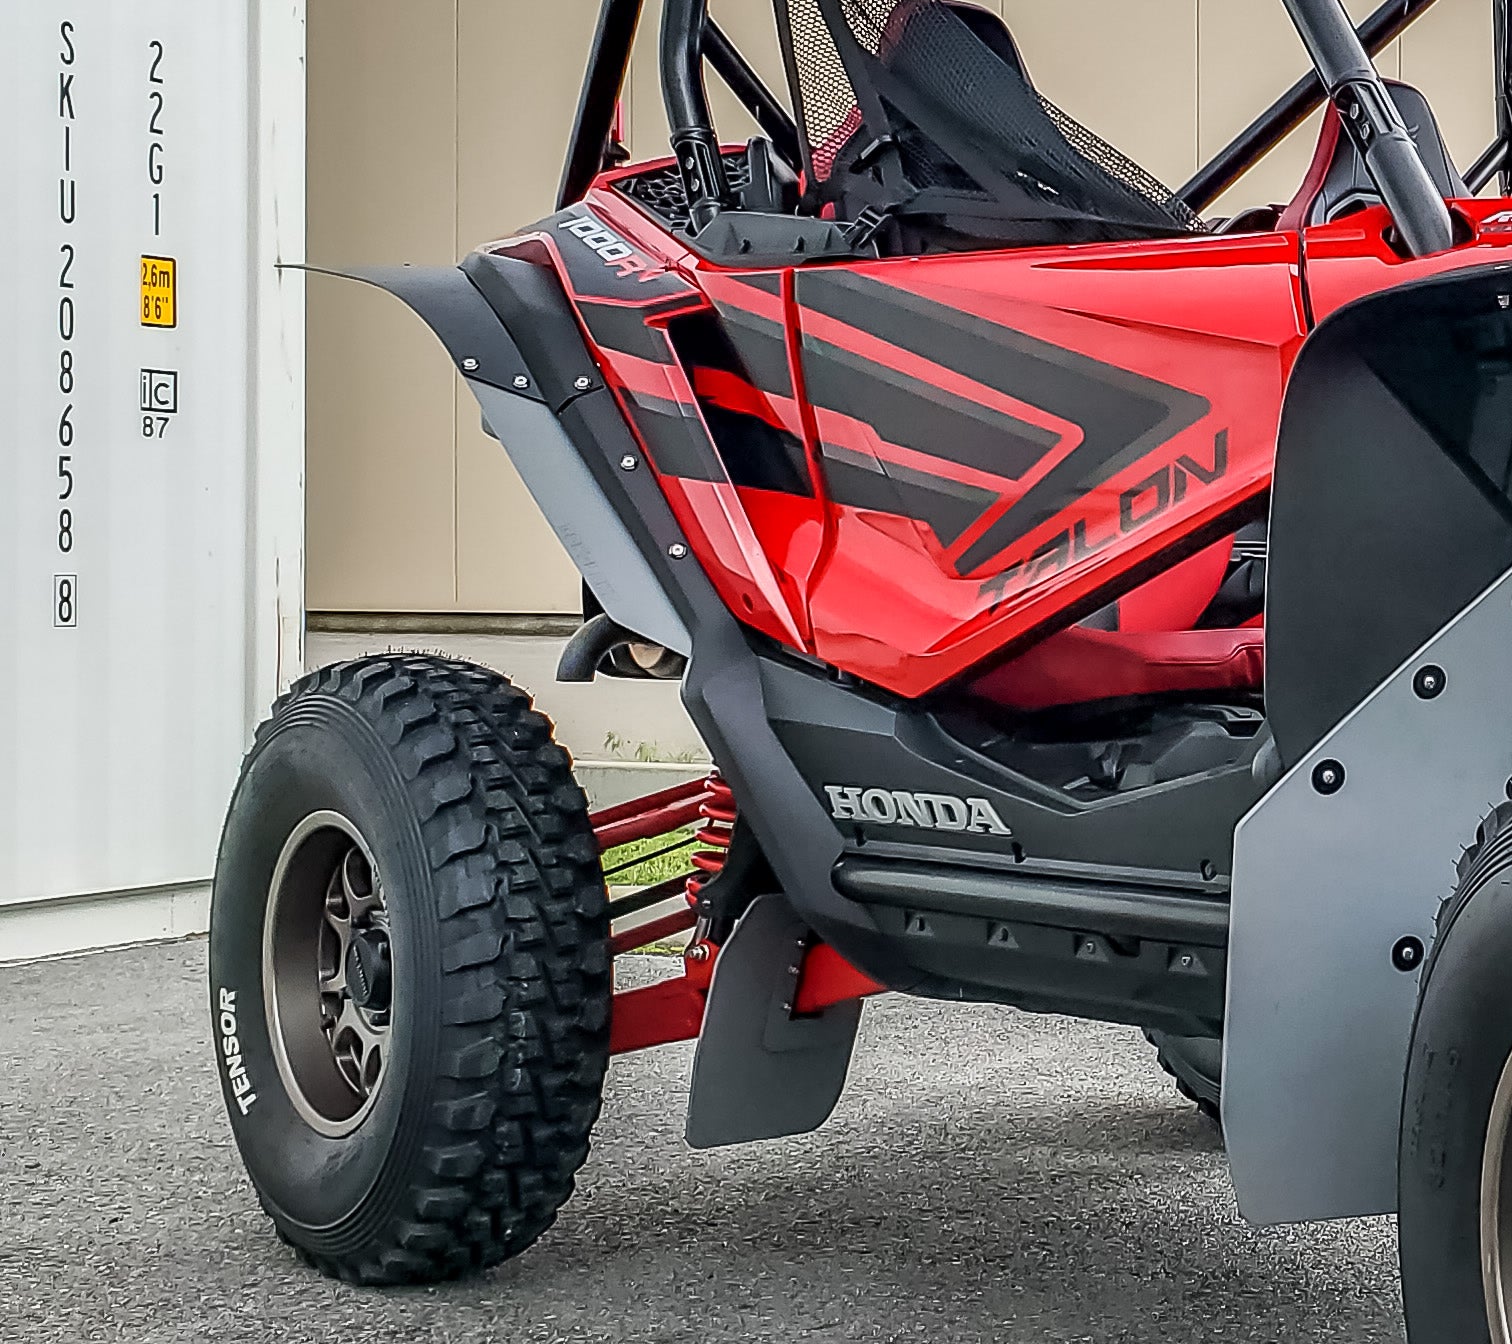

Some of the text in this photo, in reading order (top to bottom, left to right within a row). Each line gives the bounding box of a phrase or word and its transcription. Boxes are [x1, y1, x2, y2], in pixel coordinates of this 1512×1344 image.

[59, 20, 76, 224] SKIU
[148, 40, 164, 236] 22G1
[142, 415, 170, 439] 87
[823, 784, 1013, 836] HONDA
[219, 986, 258, 1116] TENSOR
